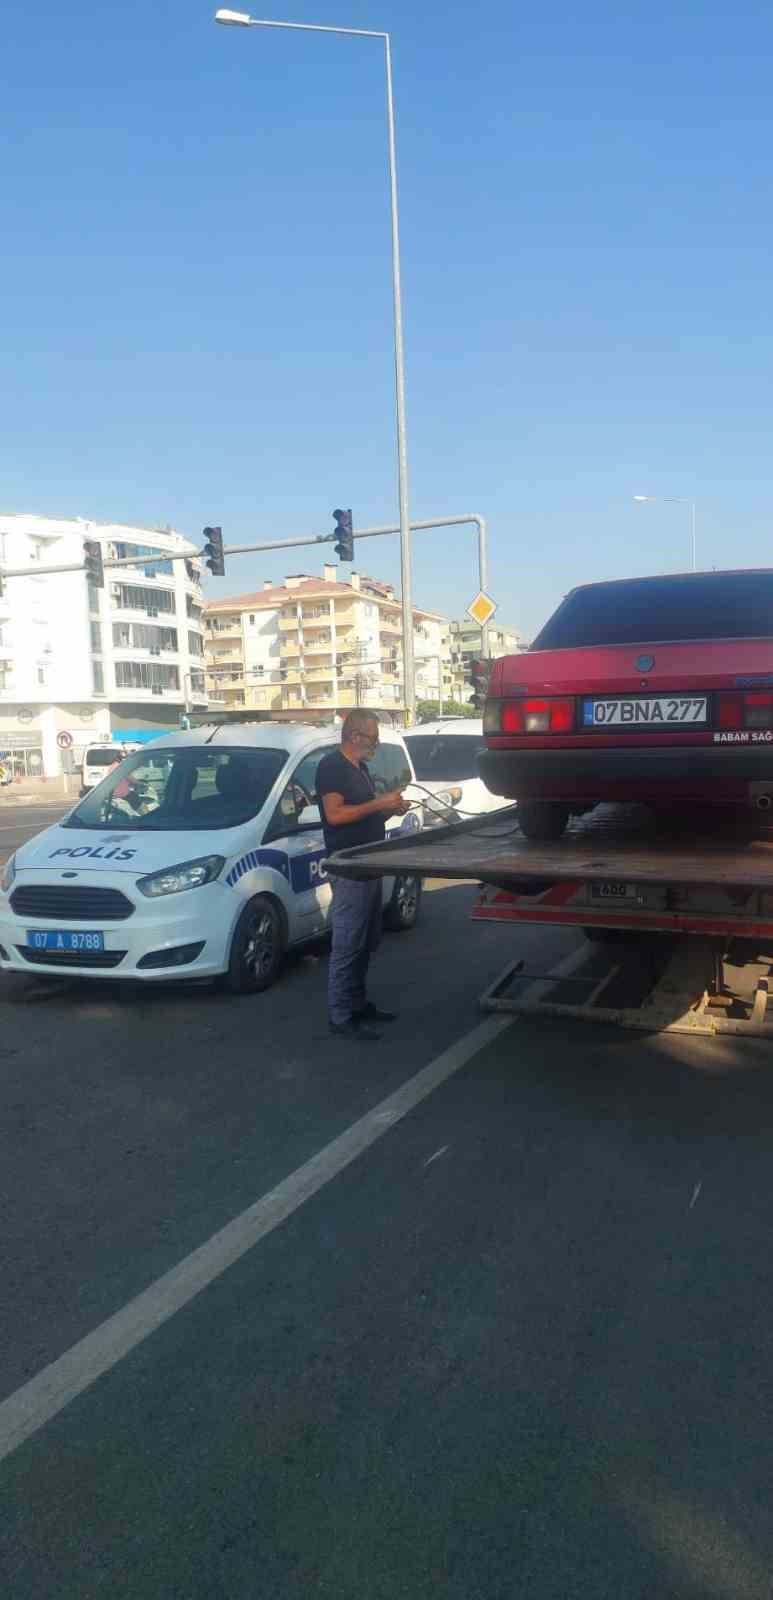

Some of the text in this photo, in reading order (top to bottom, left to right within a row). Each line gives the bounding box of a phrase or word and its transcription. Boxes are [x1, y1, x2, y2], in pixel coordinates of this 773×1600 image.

[713, 732, 749, 742] BABAM
[35, 933, 100, 949] 07 A 8788
